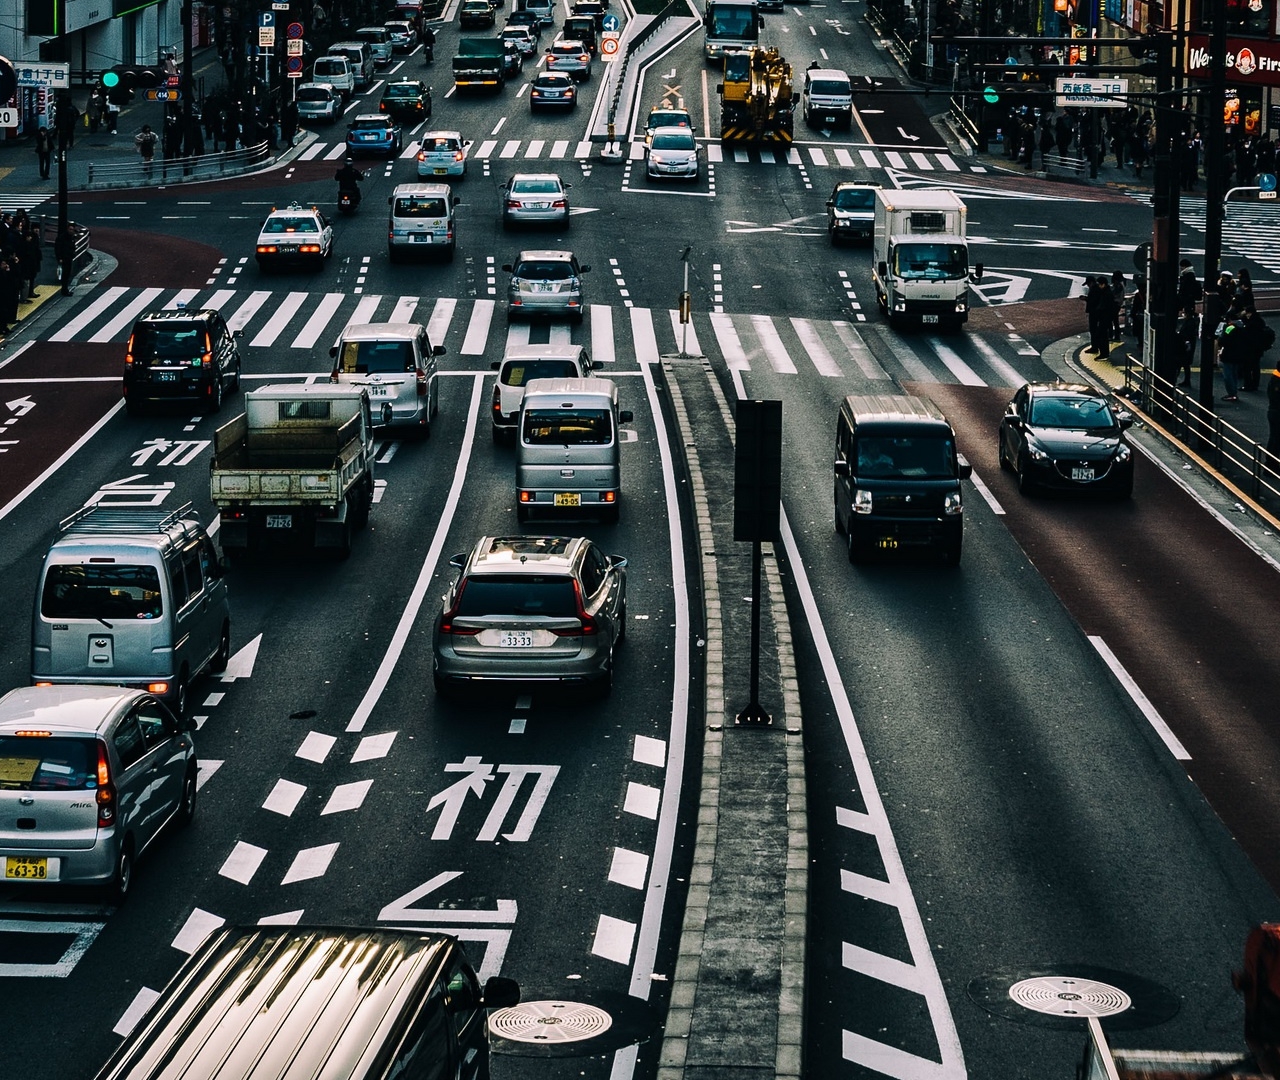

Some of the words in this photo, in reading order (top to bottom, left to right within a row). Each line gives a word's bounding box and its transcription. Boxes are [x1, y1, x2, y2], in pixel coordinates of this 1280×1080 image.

[507, 637, 532, 646] 33-33
[70, 801, 92, 809] Mira
[14, 865, 45, 878] 63-38
